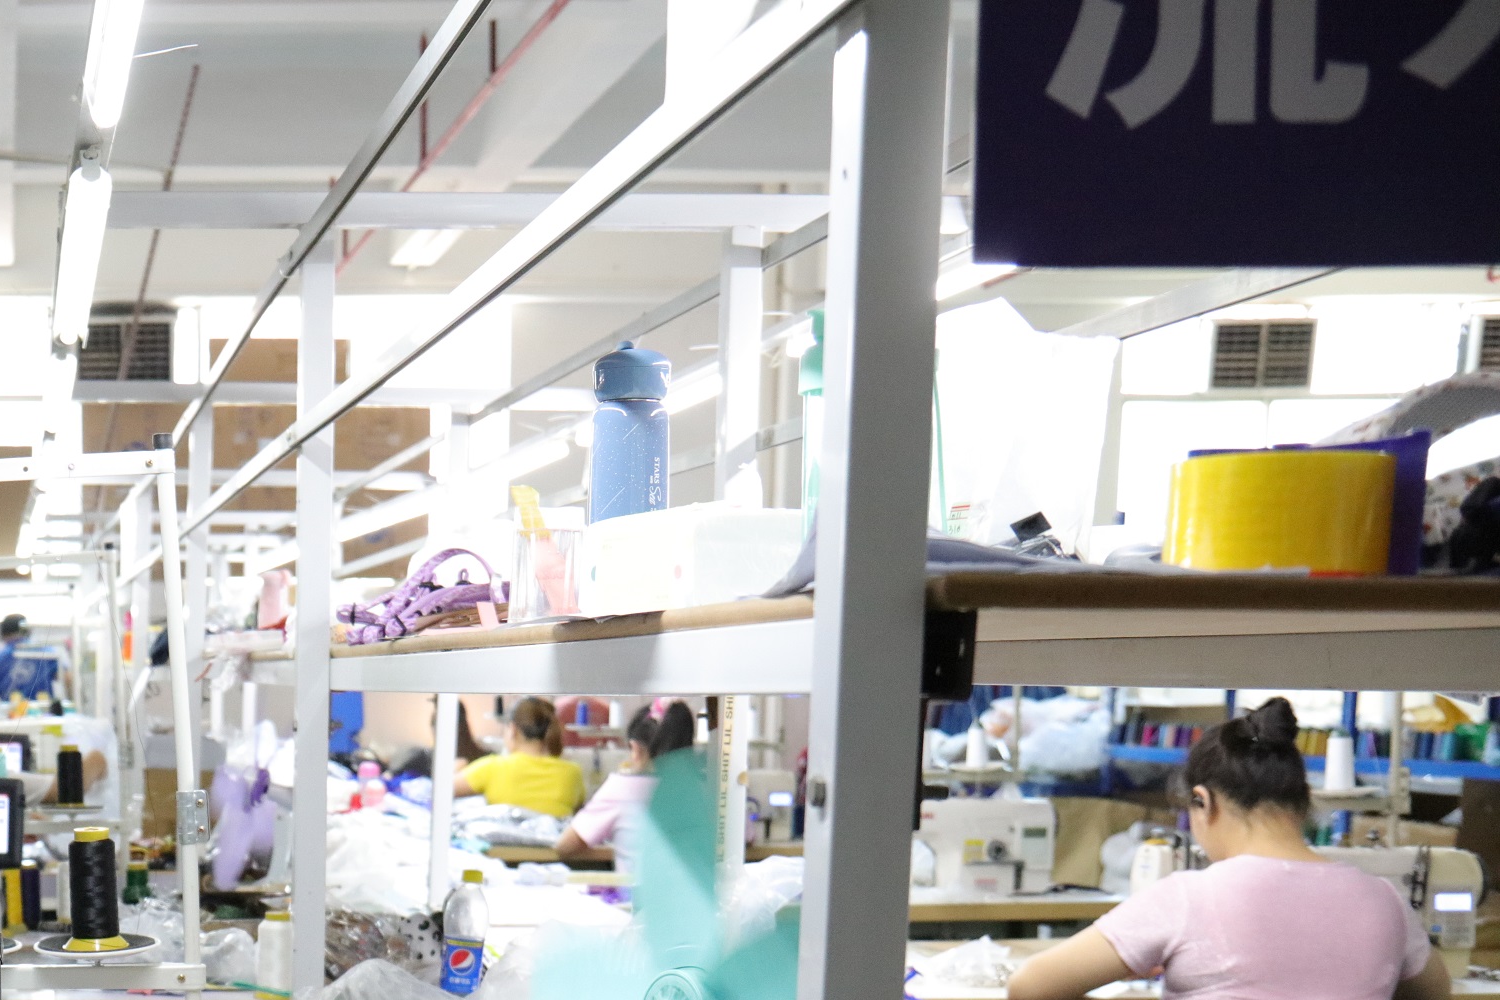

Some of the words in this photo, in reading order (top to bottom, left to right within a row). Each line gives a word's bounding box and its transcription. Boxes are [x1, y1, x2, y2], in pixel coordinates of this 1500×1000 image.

[725, 695, 734, 720] SHI
[723, 724, 732, 746] LIL
[721, 750, 730, 782] SHIT
